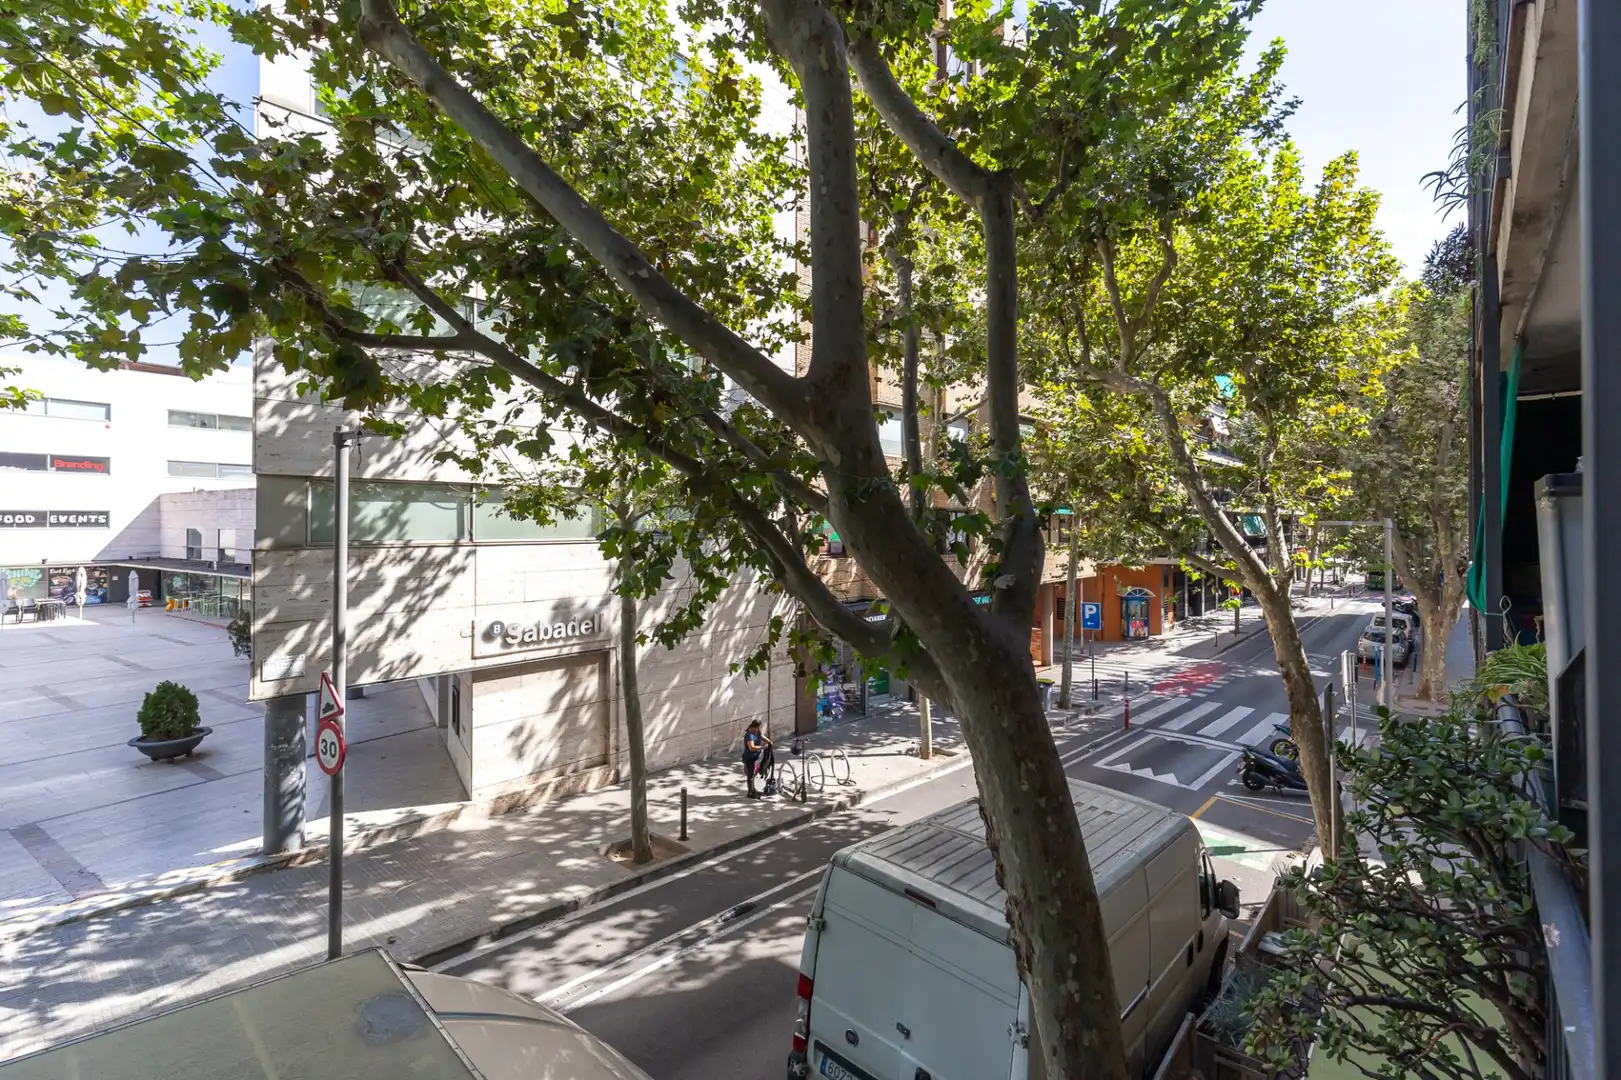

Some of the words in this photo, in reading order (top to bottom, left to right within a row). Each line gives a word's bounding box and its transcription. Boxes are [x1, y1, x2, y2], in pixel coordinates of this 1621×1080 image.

[53, 458, 104, 472] Branding
[50, 515, 107, 523] EVENTS
[1085, 604, 1097, 618] P
[505, 613, 605, 644] Sabadell
[320, 738, 338, 759] 30
